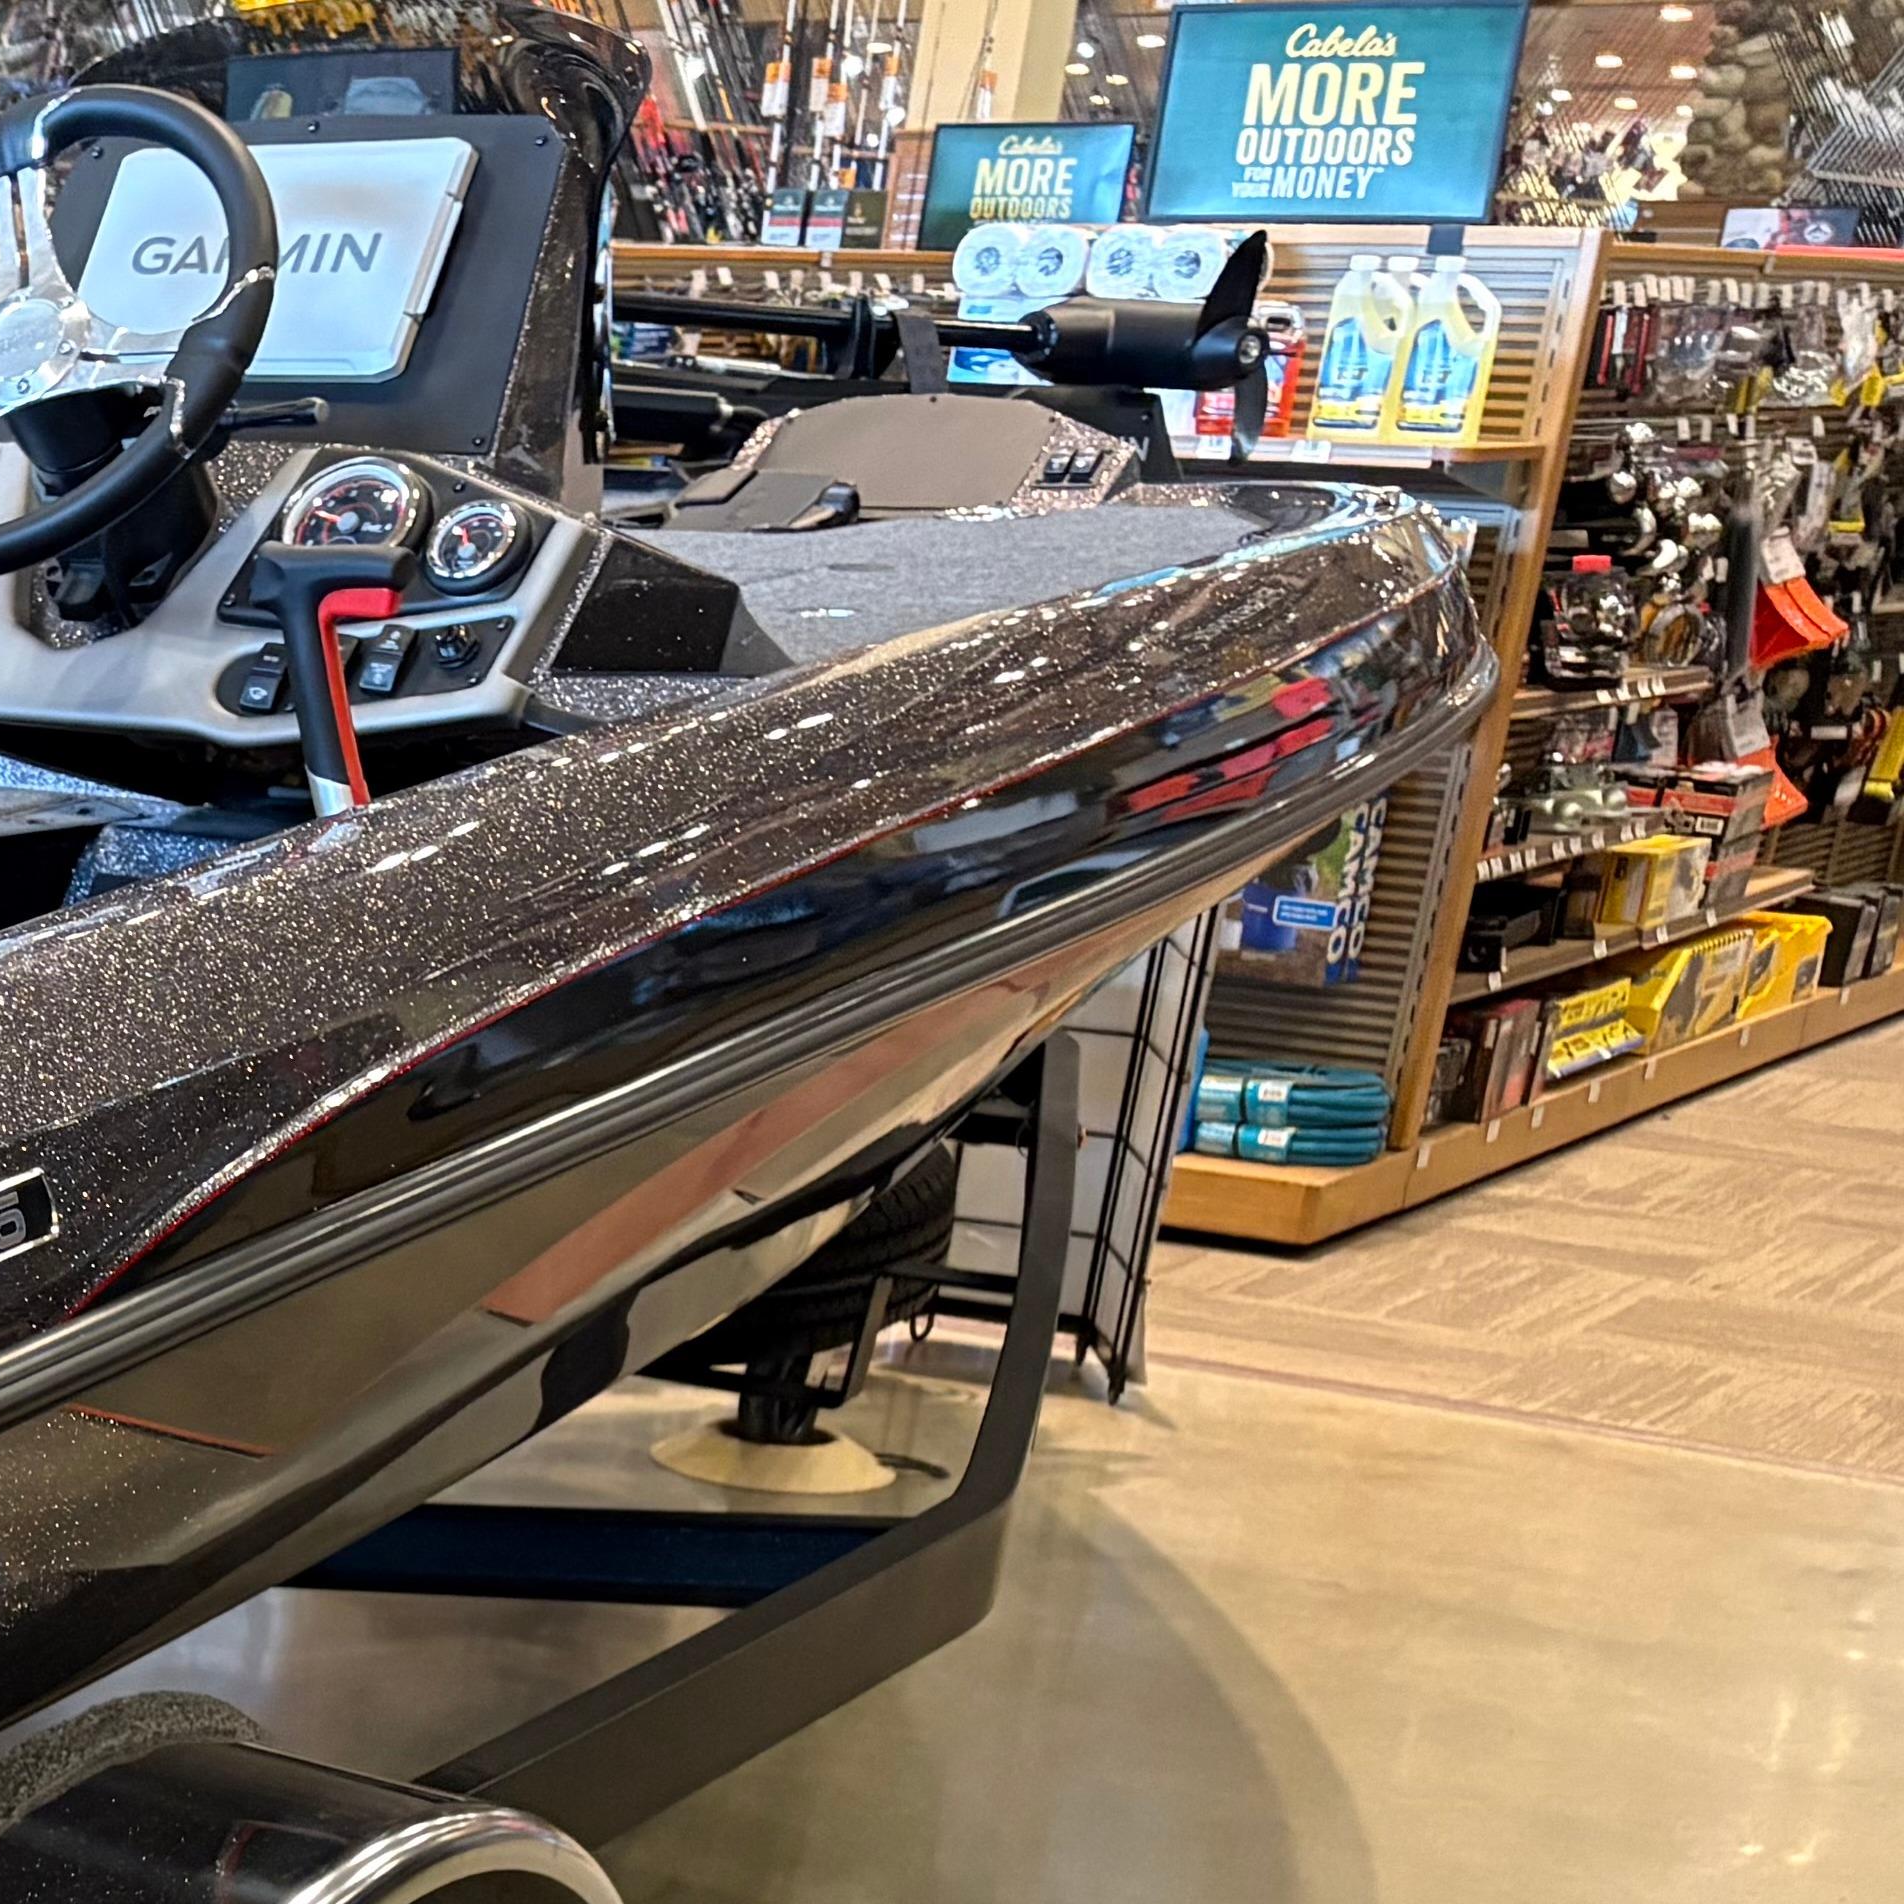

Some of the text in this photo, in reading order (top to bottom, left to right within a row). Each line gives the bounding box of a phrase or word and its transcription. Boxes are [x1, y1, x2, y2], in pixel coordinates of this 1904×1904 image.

[1285, 23, 1397, 59] Cabela's
[1242, 62, 1425, 126] MORE
[1235, 128, 1415, 167] OUTDOORS
[973, 157, 1079, 196] MORE
[1244, 167, 1273, 183] FOR
[969, 196, 1073, 220] OUTDOORS
[1326, 801, 1370, 965] CAMCO
[1348, 797, 1388, 959] CAMCO
